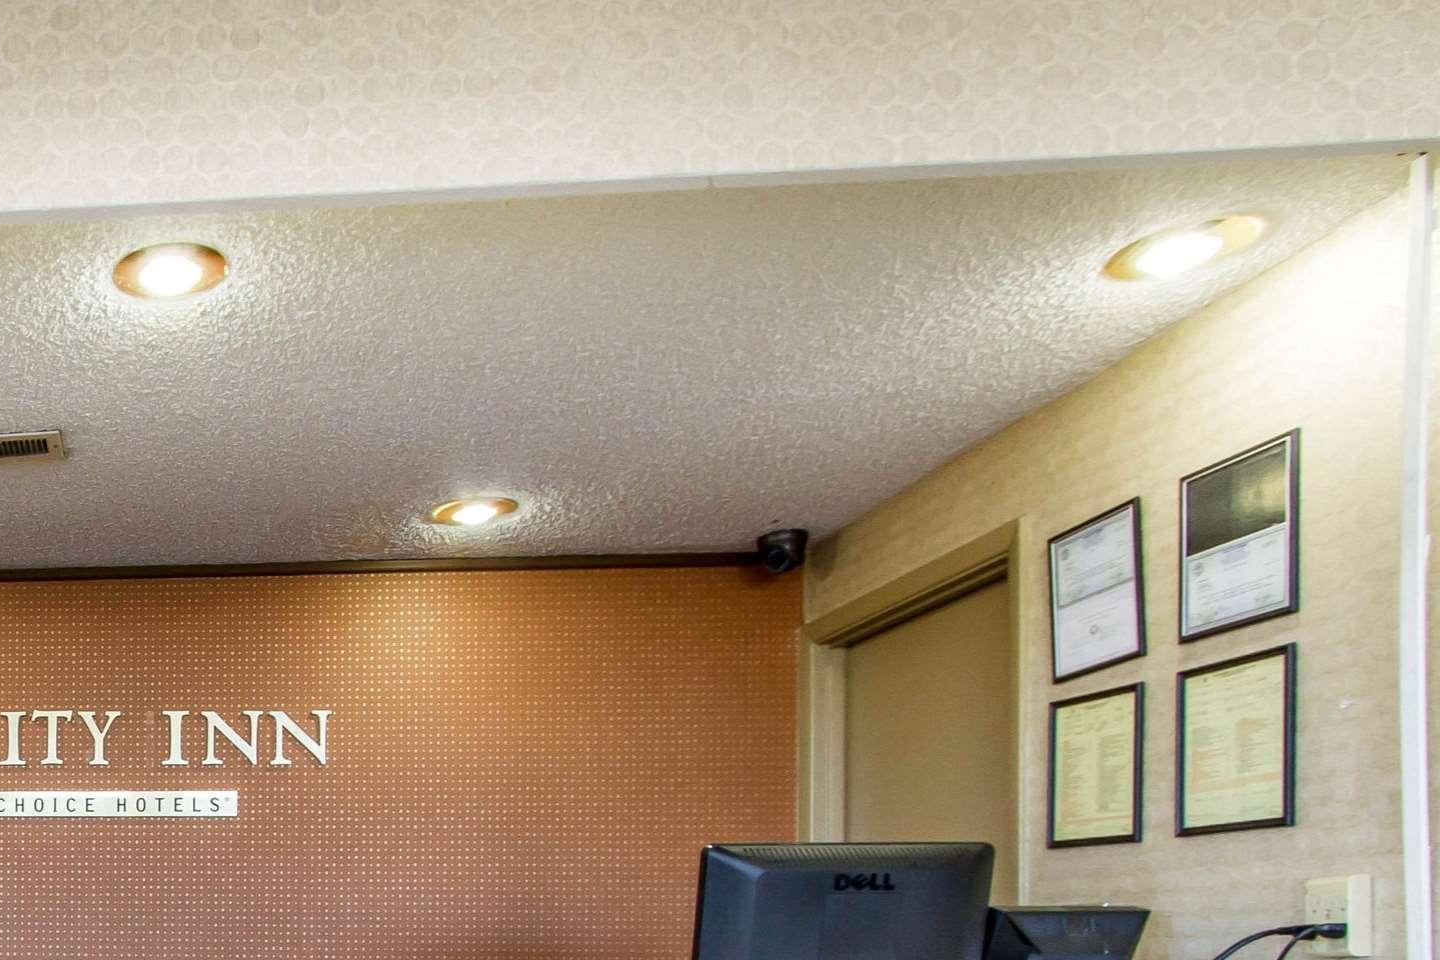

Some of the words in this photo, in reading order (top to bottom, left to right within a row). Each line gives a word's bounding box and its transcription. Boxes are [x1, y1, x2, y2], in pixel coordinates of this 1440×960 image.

[162, 710, 332, 766] INN
[116, 797, 220, 813] HOTELS
[833, 872, 895, 891] DELL
